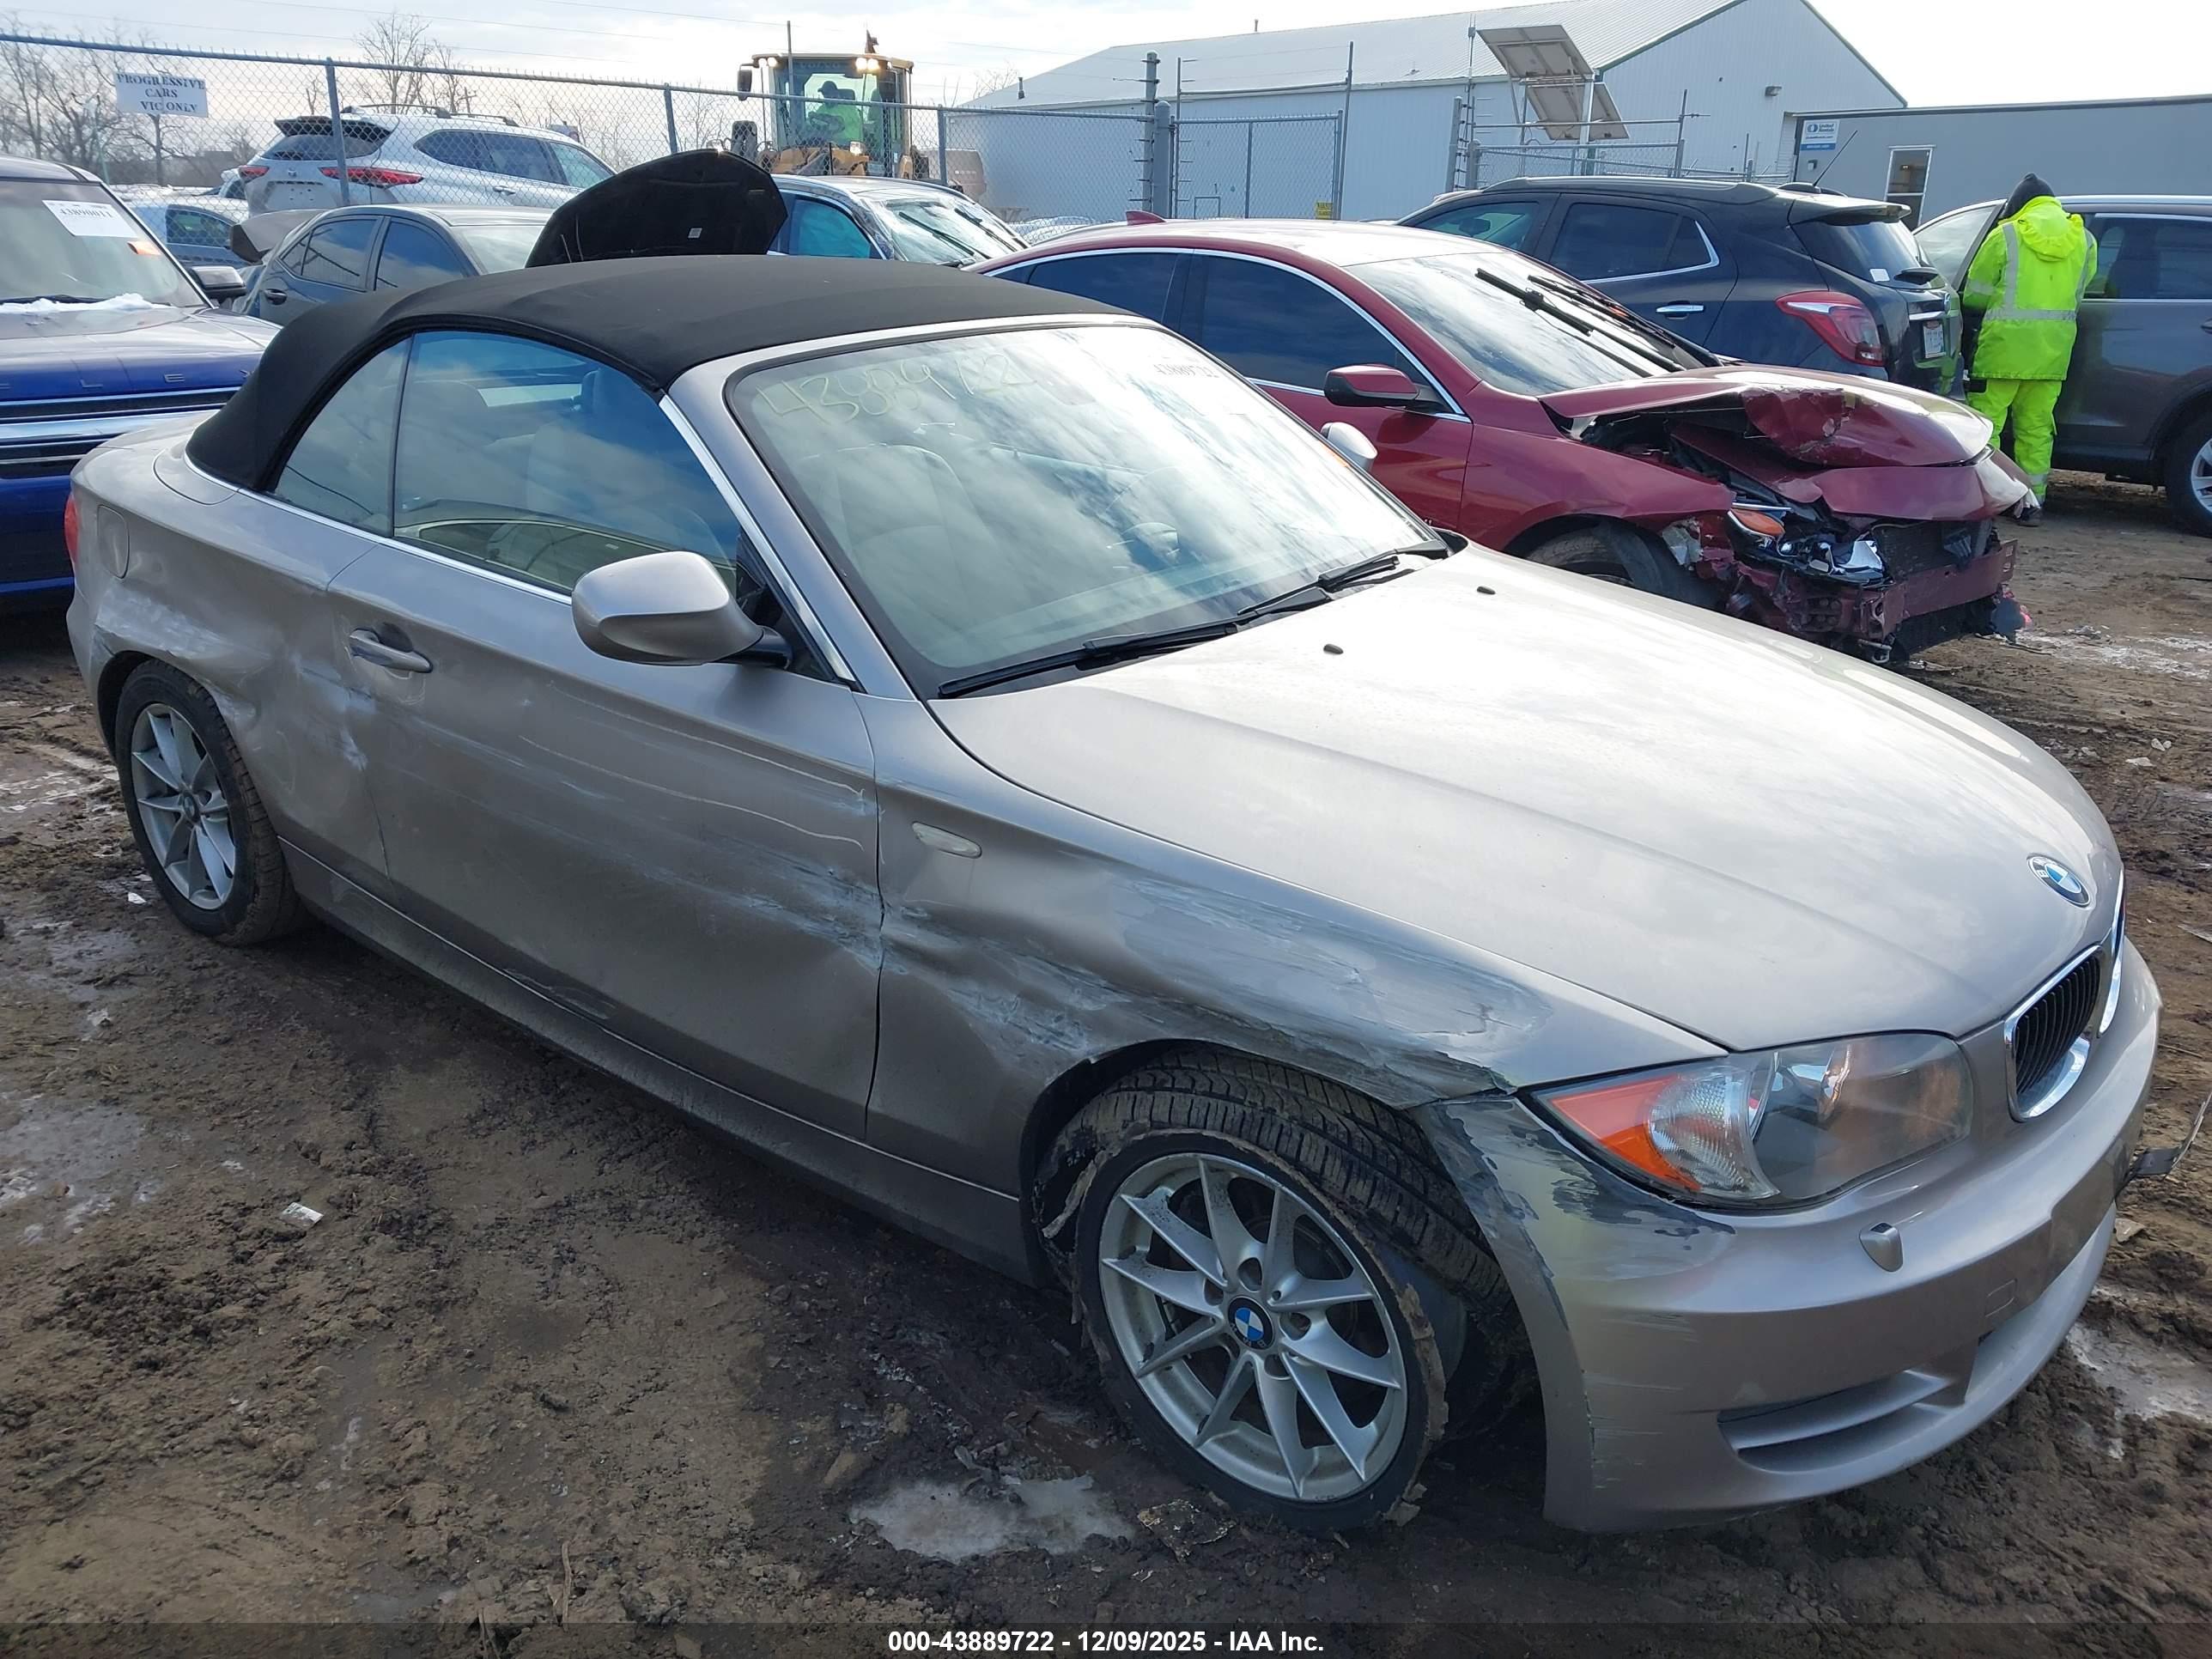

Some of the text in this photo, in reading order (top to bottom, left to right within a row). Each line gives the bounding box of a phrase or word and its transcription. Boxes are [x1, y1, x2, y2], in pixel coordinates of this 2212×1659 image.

[116, 73, 205, 90] PROGRESSIVE
[144, 88, 178, 98] CARS
[140, 100, 198, 112] VIC ONLY
